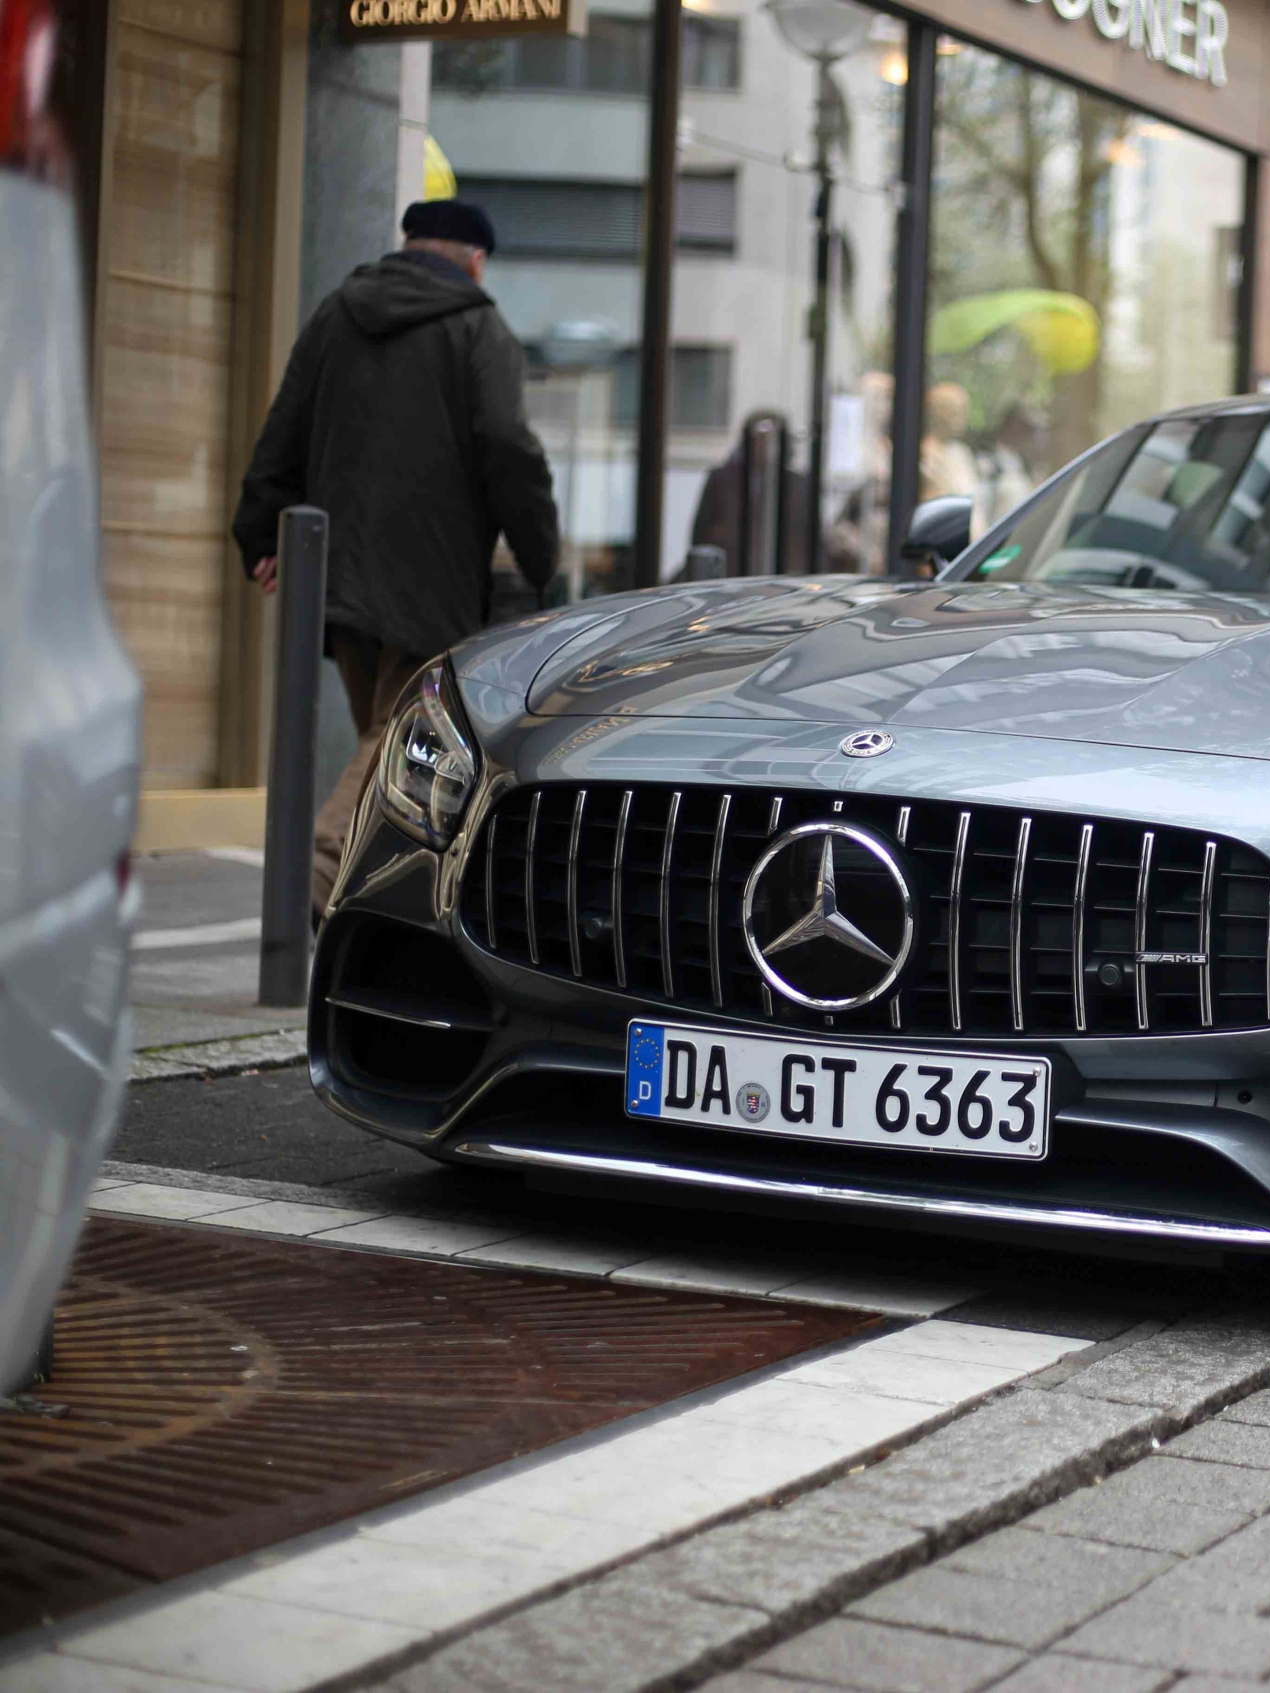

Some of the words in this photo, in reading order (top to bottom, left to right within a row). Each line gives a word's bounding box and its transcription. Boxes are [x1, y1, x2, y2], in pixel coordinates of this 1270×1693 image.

[350, 0, 457, 27] GIORGIO
[461, 0, 562, 23] ARMANI
[1159, 954, 1207, 963] AMG
[639, 1081, 652, 1100] D
[665, 1039, 731, 1115] DA
[780, 1053, 857, 1128] GT
[876, 1063, 1037, 1143] 6363
